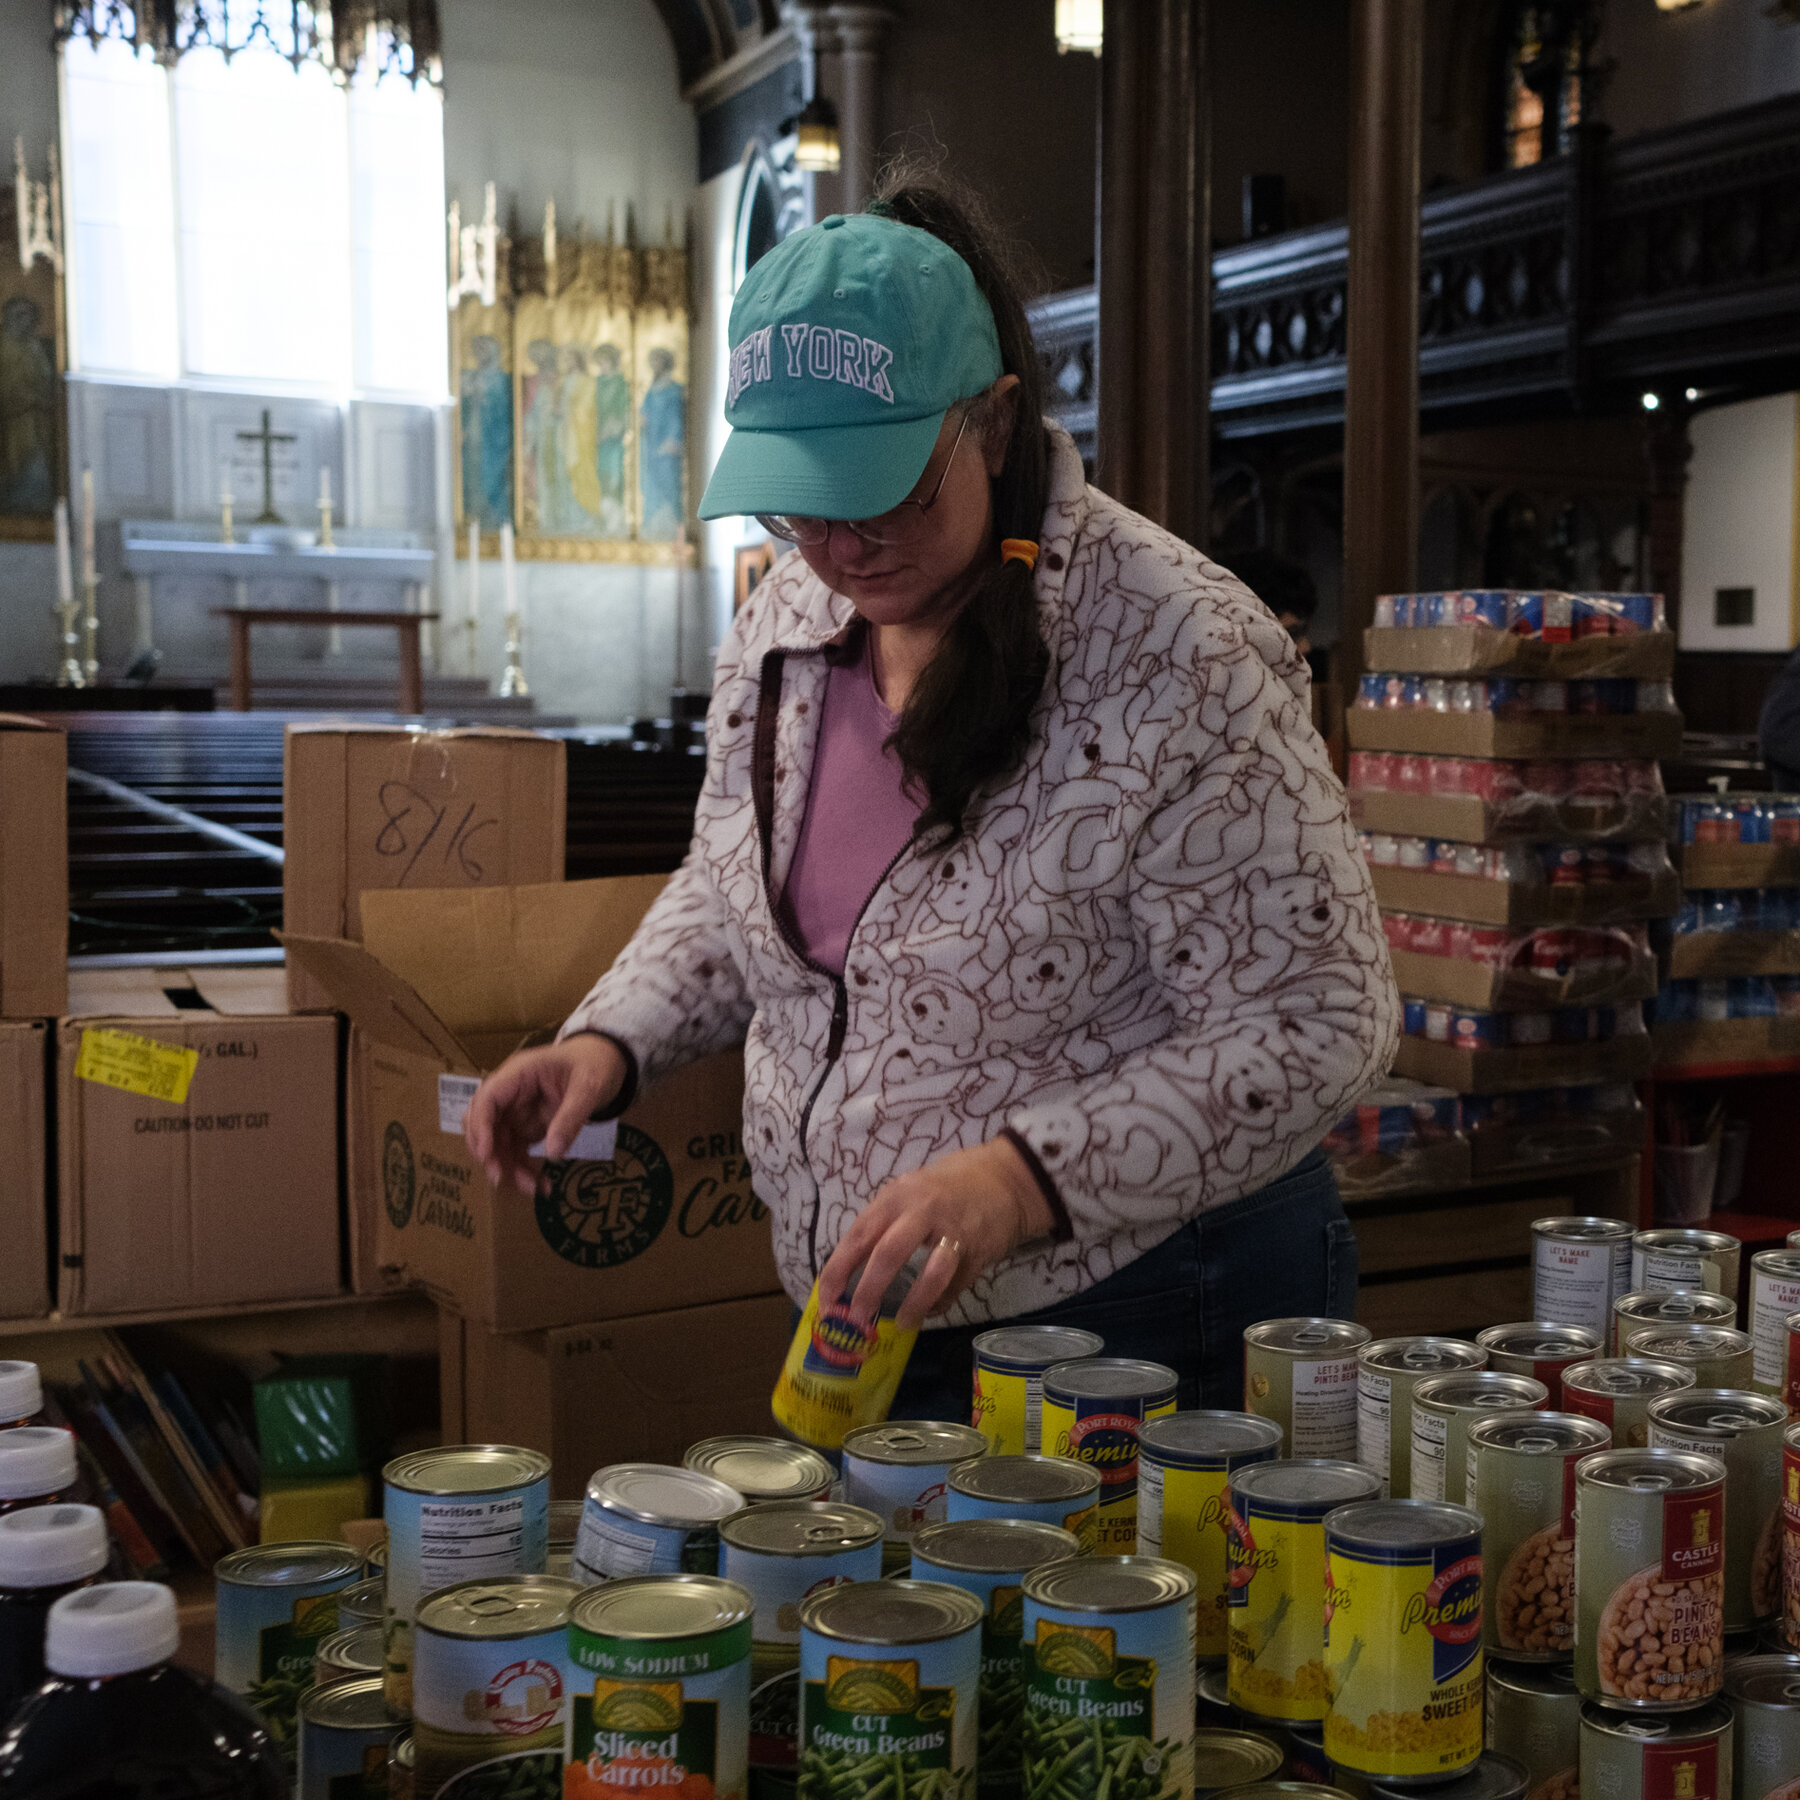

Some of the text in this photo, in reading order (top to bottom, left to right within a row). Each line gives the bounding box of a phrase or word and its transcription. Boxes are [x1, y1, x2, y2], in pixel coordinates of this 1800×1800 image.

[729, 323, 894, 409] NEW YORK
[135, 1117, 191, 1134] CAUTION
[195, 1115, 213, 1130] DO
[216, 1113, 241, 1129] NOT
[687, 1132, 744, 1160] GRI
[722, 1160, 753, 1184] FA
[678, 1176, 770, 1239] Car
[559, 1229, 651, 1264] FARMS
[1680, 1261, 1701, 1270] Facts
[1789, 1286, 1800, 1296] MA
[1314, 1373, 1339, 1385] PINTO
[1370, 1375, 1390, 1388] Facts
[1077, 1416, 1108, 1436] PORT
[1424, 1415, 1446, 1430] Facts
[1692, 1443, 1723, 1454] Facts
[422, 1500, 524, 1518] Nutrition Facts
[1671, 1543, 1720, 1563] CASTLE
[1680, 1557, 1715, 1570] CANNING
[1435, 1561, 1466, 1591] PORT
[1674, 1600, 1717, 1625] PINTO
[1671, 1624, 1718, 1646] BEANS
[579, 1645, 710, 1675] LOW SODIUM
[1055, 1676, 1090, 1696] CUT
[1430, 1686, 1465, 1703] WHOLE
[1026, 1683, 1145, 1719] Green Beans
[1421, 1701, 1468, 1722] SWEET
[851, 1713, 891, 1733] CUT
[593, 1730, 680, 1760] Sliced
[812, 1723, 871, 1756] Green
[876, 1728, 946, 1756] Beans
[586, 1754, 685, 1787] Carrots
